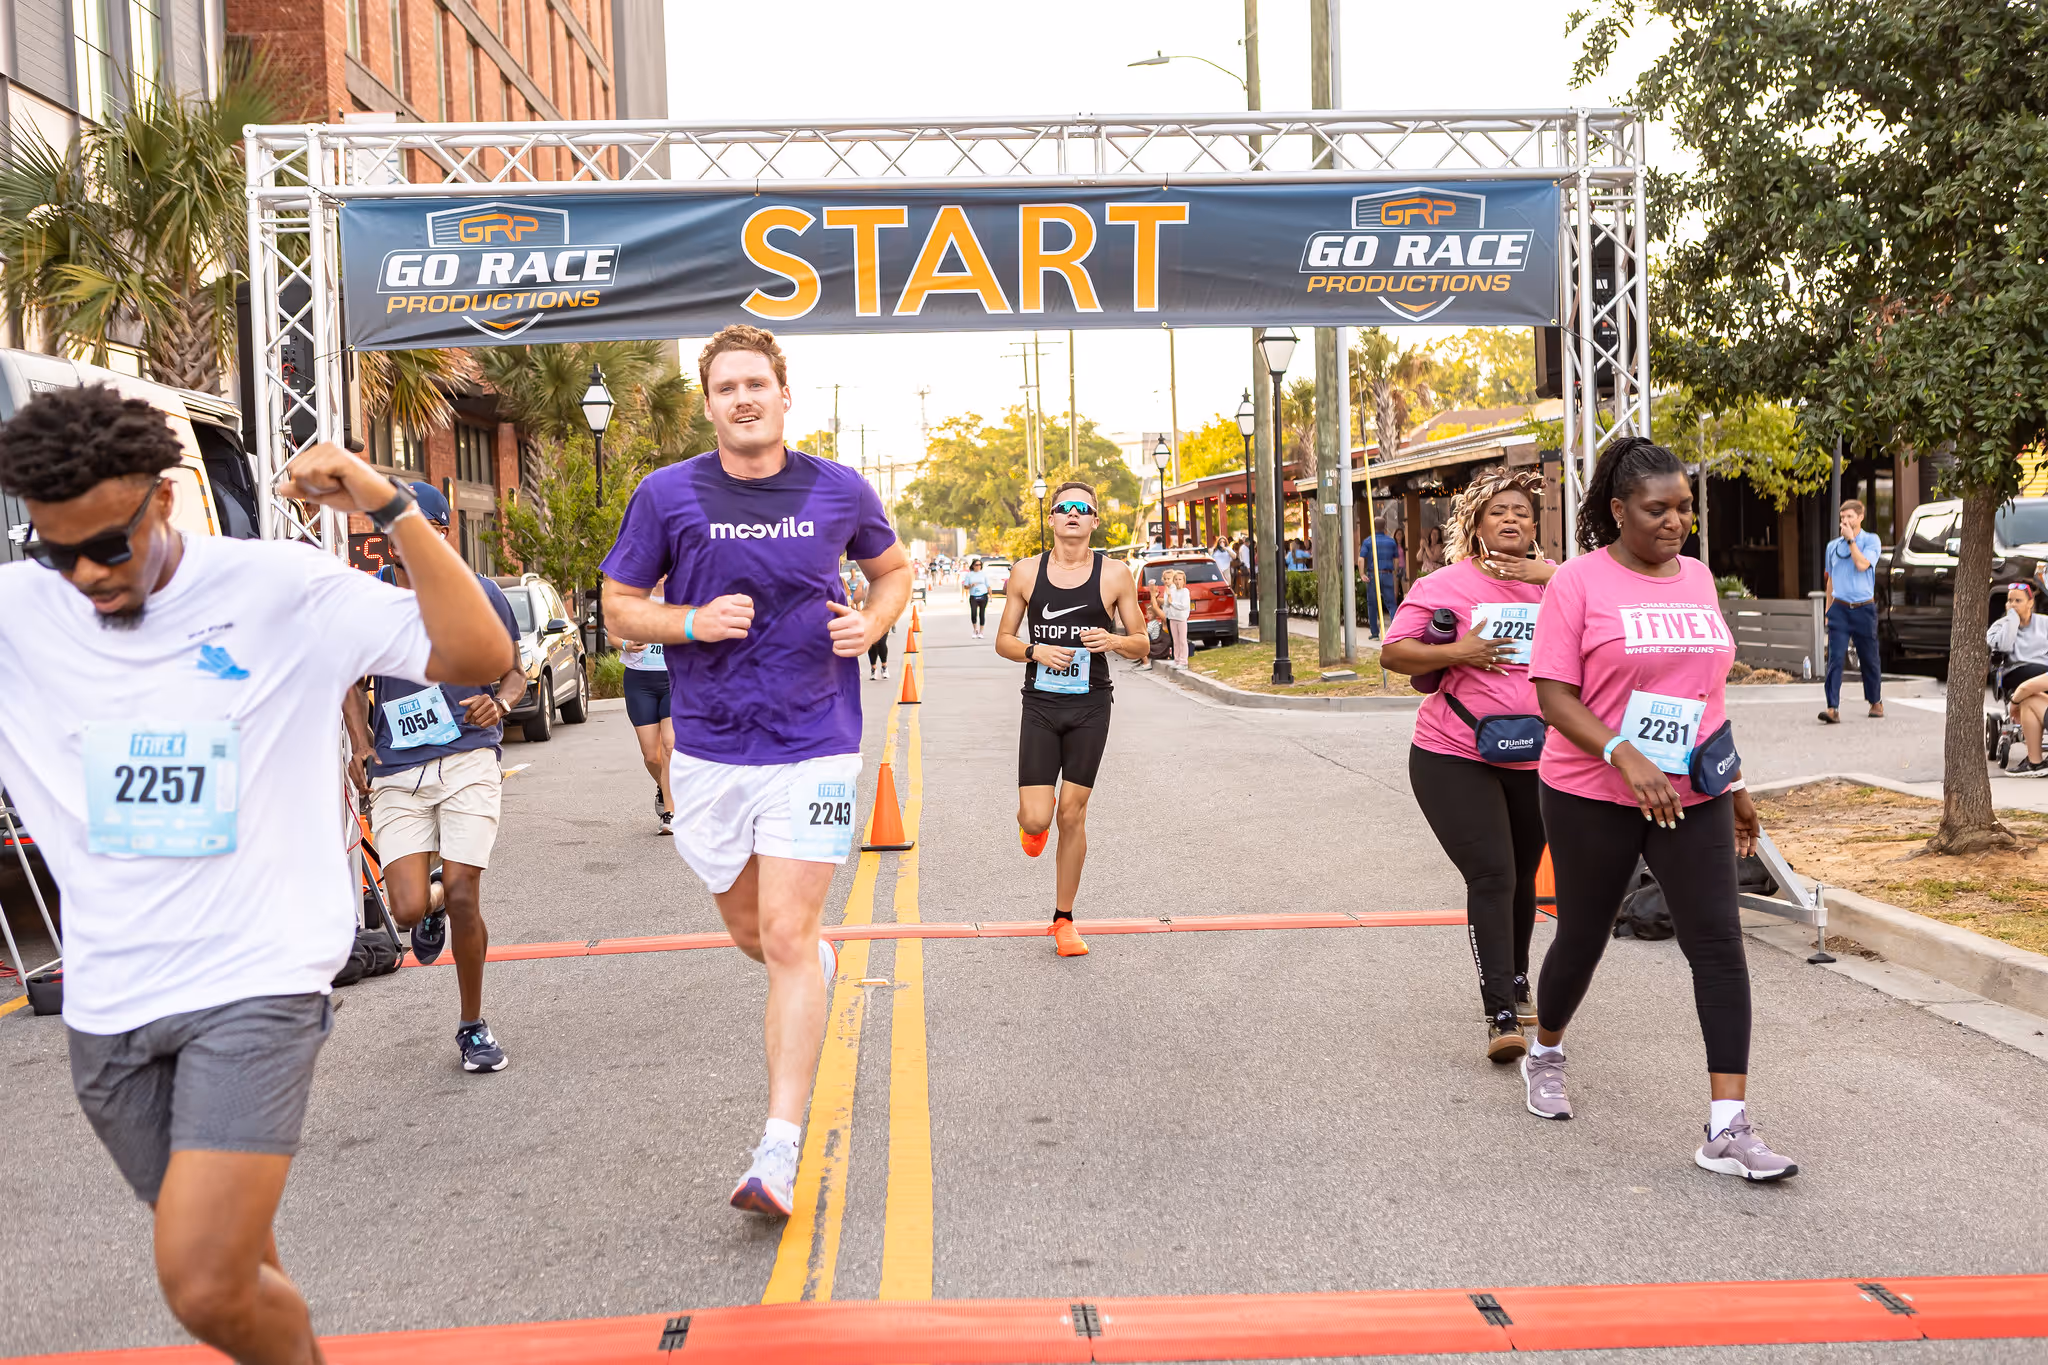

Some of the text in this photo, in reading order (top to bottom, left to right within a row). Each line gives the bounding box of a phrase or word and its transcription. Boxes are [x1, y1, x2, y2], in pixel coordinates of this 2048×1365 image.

[1380, 197, 1457, 226] GRP
[459, 213, 539, 243] GRP
[740, 201, 1190, 321] START
[1307, 234, 1528, 267] GO RACE
[385, 249, 616, 287] GO RACE
[1307, 274, 1512, 293] PRODUCTIONS
[386, 290, 601, 314] PRODUCTIONS
[709, 516, 815, 540] moovila
[1034, 624, 1067, 639] STOP
[1493, 620, 1536, 641] 2225
[1624, 646, 1663, 655] WHERE
[1688, 646, 1715, 654] RUNS
[397, 708, 439, 737] 2054
[1638, 717, 1690, 746] 2231
[114, 765, 206, 804] 2257
[808, 801, 851, 826] 2243
